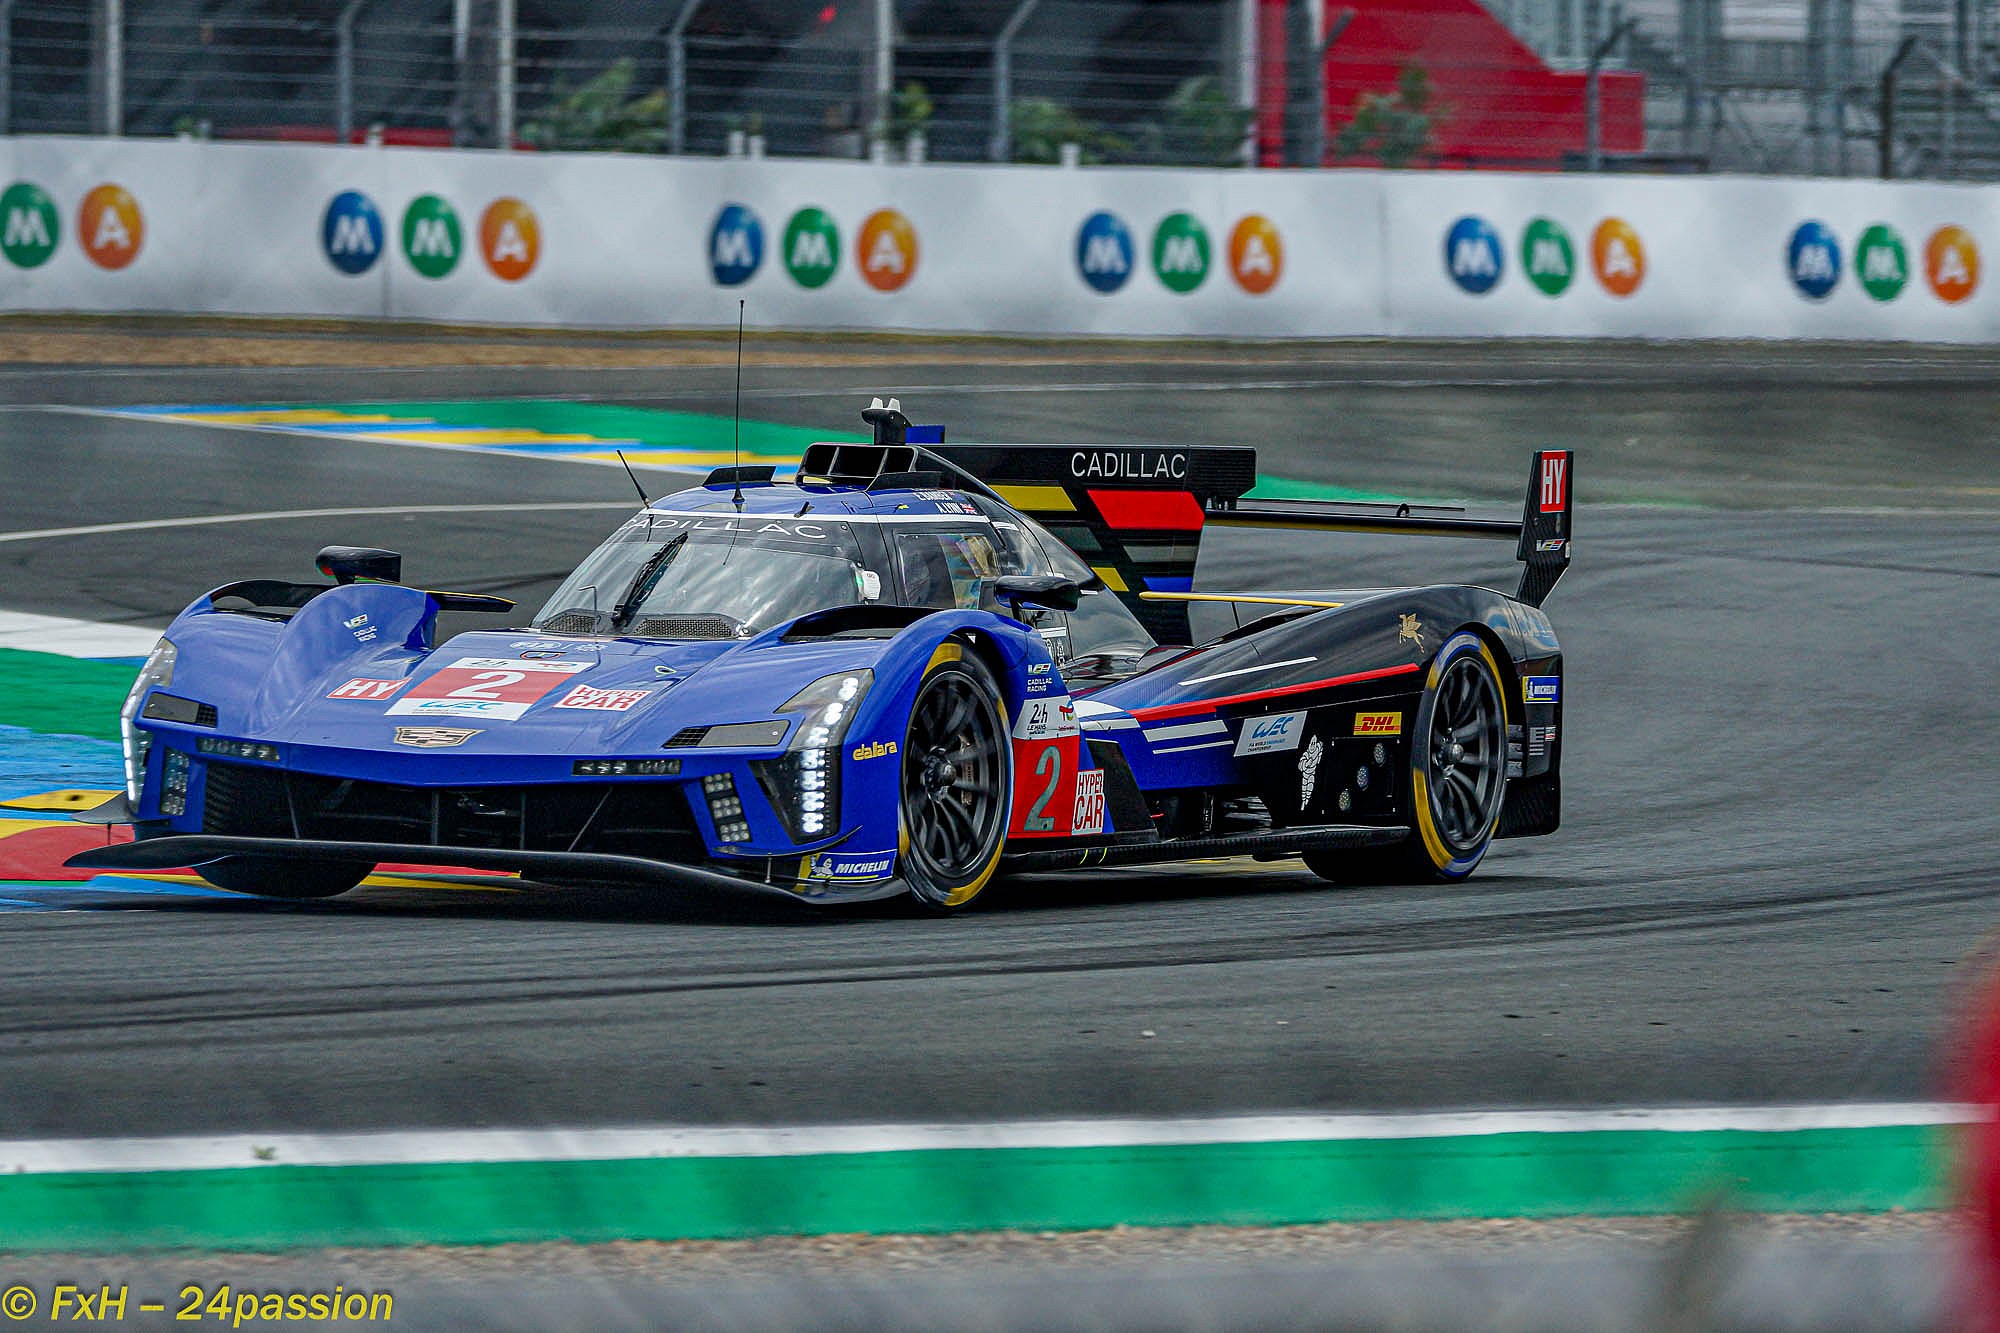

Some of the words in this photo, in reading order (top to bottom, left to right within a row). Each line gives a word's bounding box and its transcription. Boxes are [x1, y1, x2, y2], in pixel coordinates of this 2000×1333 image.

[1071, 452, 1185, 478] CADILLAC
[1541, 459, 1565, 504] HY
[333, 680, 405, 698] HY
[446, 670, 526, 699] 2
[576, 686, 647, 698] HYPER
[562, 695, 636, 709] CAR
[1251, 716, 1295, 739] WEC
[1360, 716, 1394, 732] DHL
[852, 741, 898, 761] dallara
[1023, 745, 1062, 832] 2
[1077, 771, 1103, 796] HYPER
[1074, 793, 1104, 830] CAR
[835, 859, 890, 874] MICHELIN
